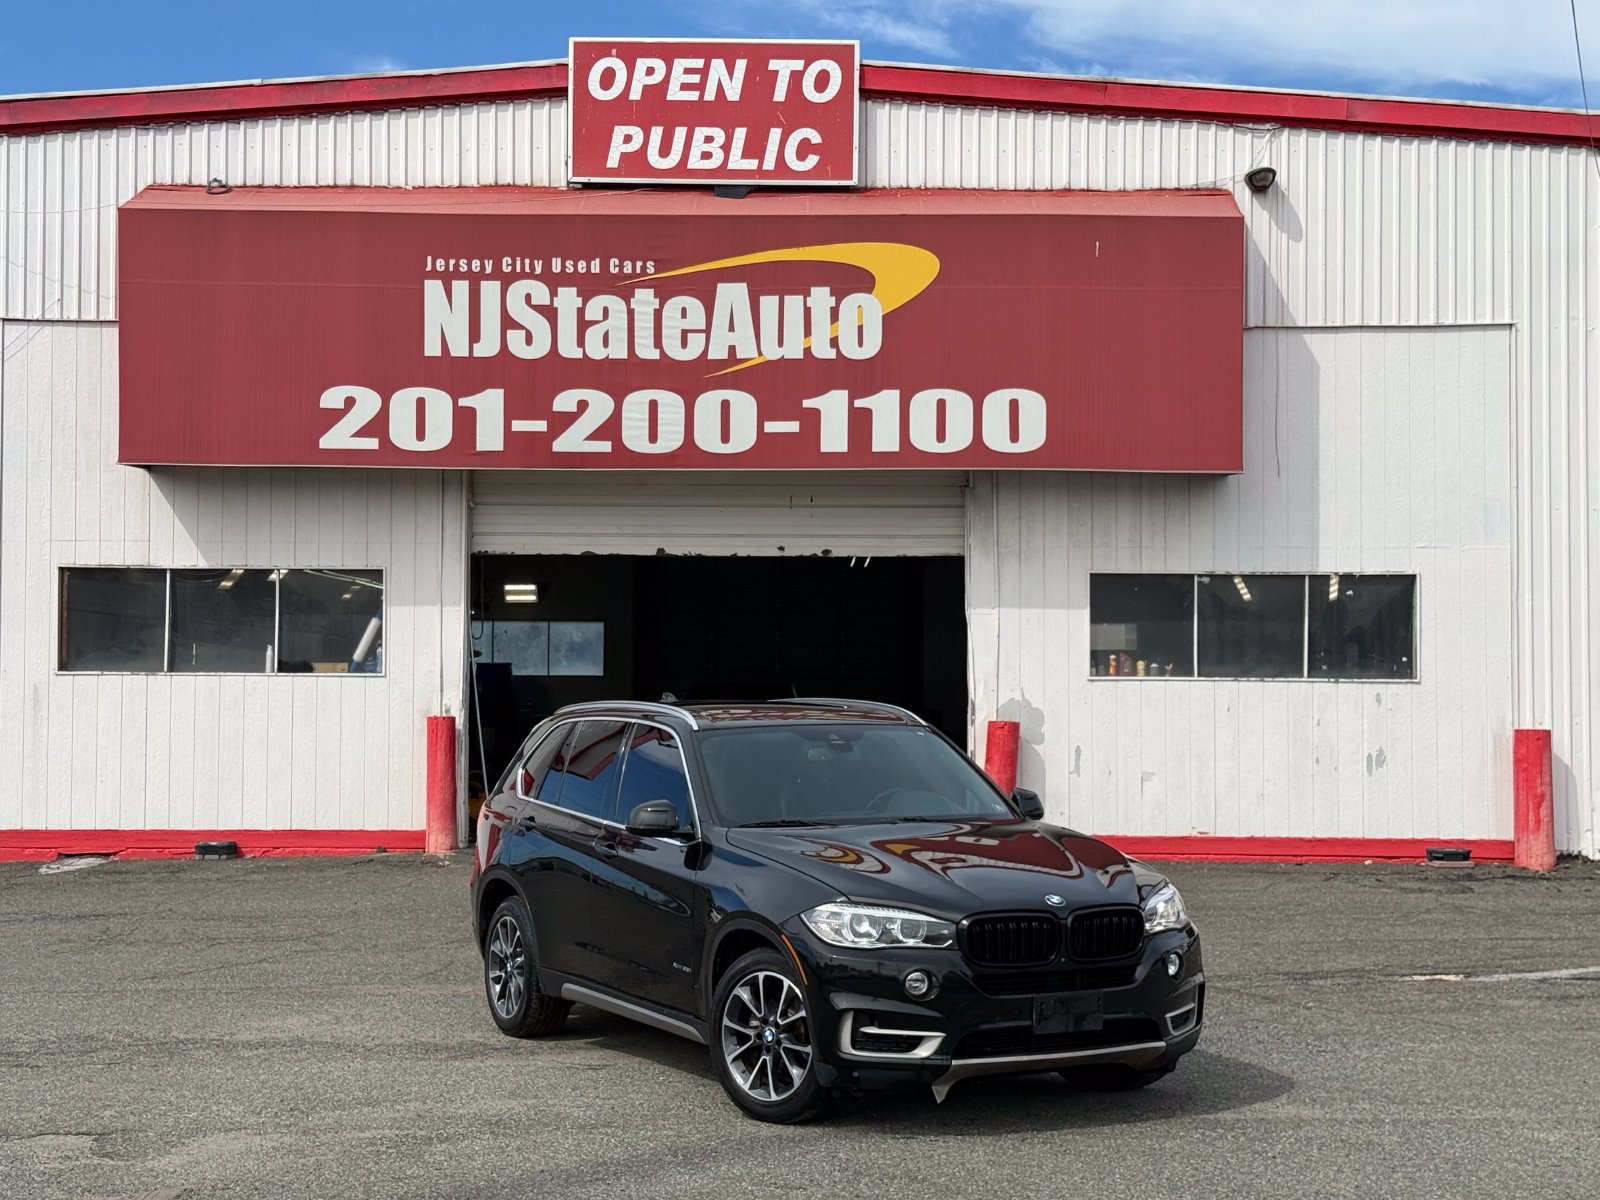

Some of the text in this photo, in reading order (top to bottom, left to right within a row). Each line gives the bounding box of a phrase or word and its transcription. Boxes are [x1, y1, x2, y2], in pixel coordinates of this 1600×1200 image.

[587, 56, 843, 104] OPEN TO
[605, 125, 823, 172] PUBLIC
[425, 255, 656, 275] Jersey City Used Cars
[423, 279, 885, 361] NJStateAuto
[318, 385, 1048, 454] 201-200-1100
